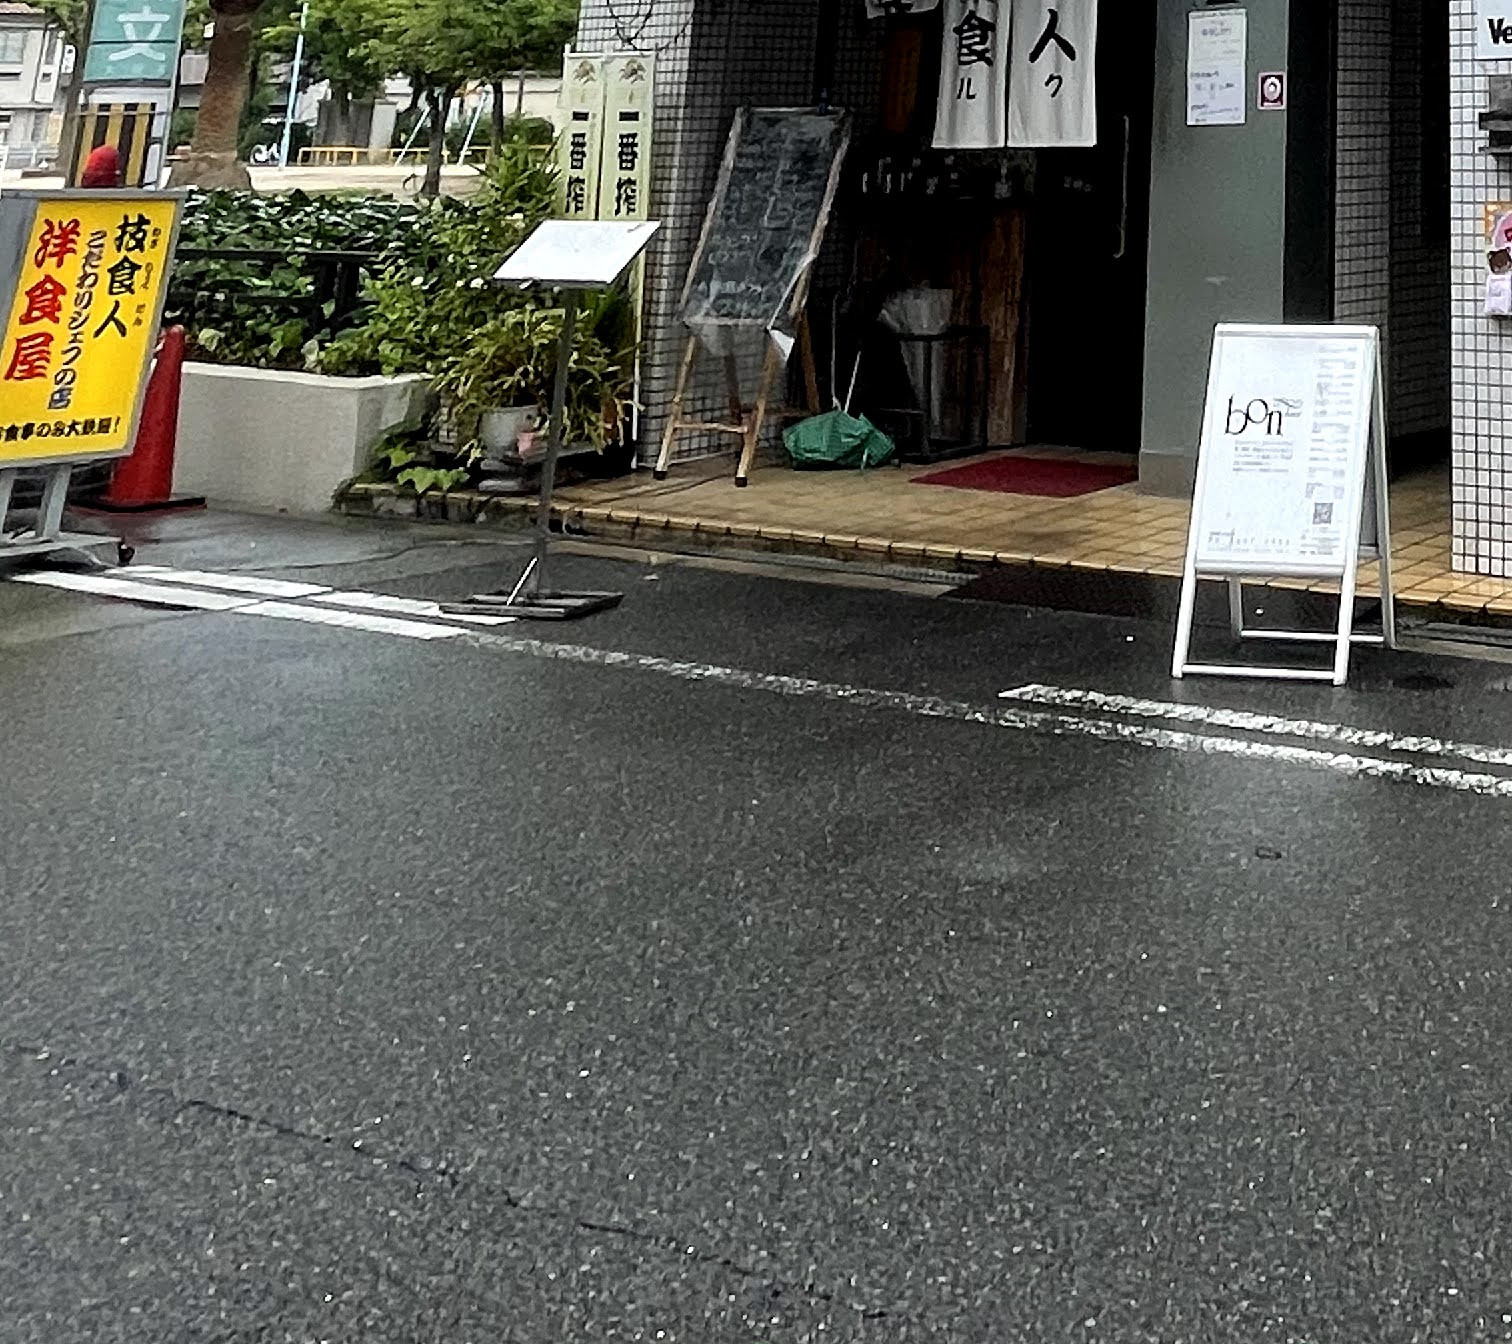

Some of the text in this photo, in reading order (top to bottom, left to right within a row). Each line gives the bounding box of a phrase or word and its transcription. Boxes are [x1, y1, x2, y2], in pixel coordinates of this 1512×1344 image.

[108, 4, 171, 62] 文
[3, 218, 82, 381] 洋食屋
[46, 228, 108, 410] こだわりシェフの店
[92, 212, 152, 340] 技食人
[1223, 393, 1284, 437] bon
